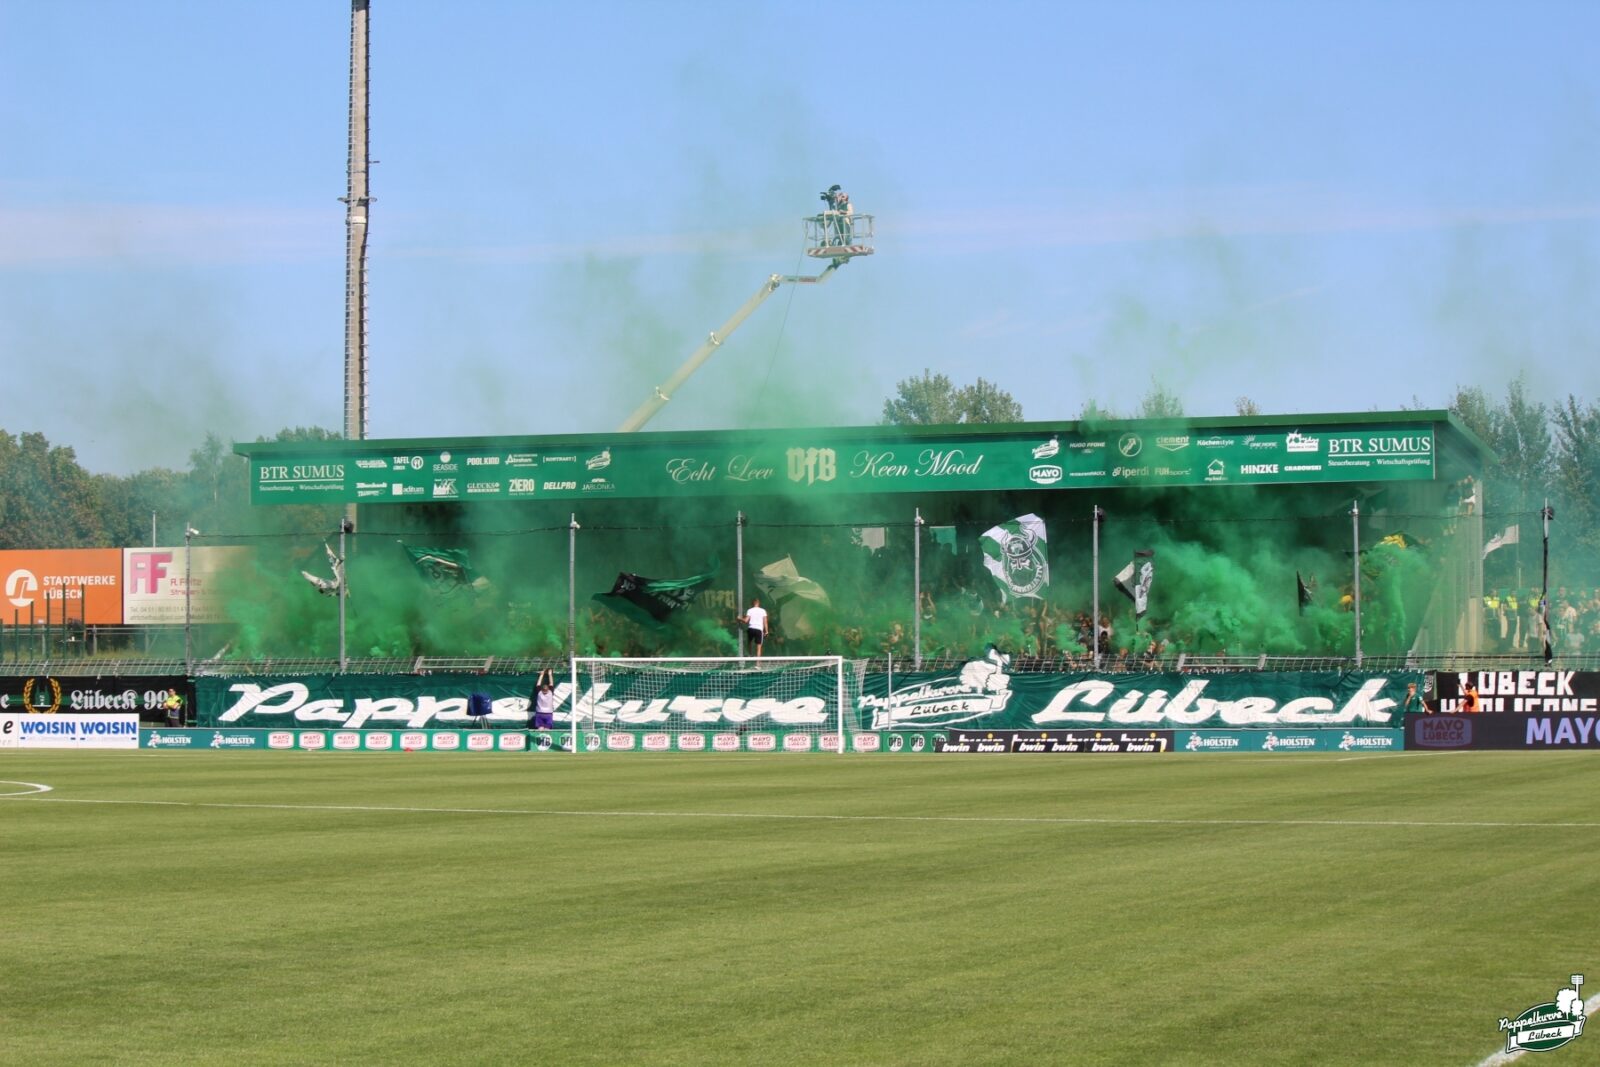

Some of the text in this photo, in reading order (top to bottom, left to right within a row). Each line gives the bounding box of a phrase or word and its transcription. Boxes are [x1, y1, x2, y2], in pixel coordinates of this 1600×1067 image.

[1327, 438, 1363, 453] BTR
[1368, 436, 1431, 452] SUMUS
[850, 448, 984, 478] Keen Mood
[259, 464, 344, 479] BTR SUMUS
[1032, 469, 1059, 478] MAYO
[1240, 464, 1279, 474] HINZKE
[543, 481, 577, 490] DELLPRO
[43, 575, 116, 586] STADTWERKE
[70, 690, 139, 710] Lübeck
[218, 679, 1398, 729] Pappelkurve Lübeck
[910, 702, 969, 716] Lübeck
[20, 721, 76, 735] WOISIN
[80, 721, 137, 735] WOISIN
[1423, 719, 1464, 730] MAYO
[1526, 717, 1600, 745] MAY
[162, 736, 192, 745] HOLSTEN
[225, 737, 256, 745] HOLSTEN
[1203, 738, 1239, 747] HOLSTEN
[1279, 738, 1315, 747] HOLSTEN
[1356, 738, 1393, 747] HOLSTEN
[942, 742, 971, 752] bwin
[977, 742, 1005, 752] bwin
[1019, 742, 1045, 752] bwin
[1051, 742, 1078, 752] bwin
[1091, 742, 1119, 752] bwin
[1126, 742, 1154, 752] bwin
